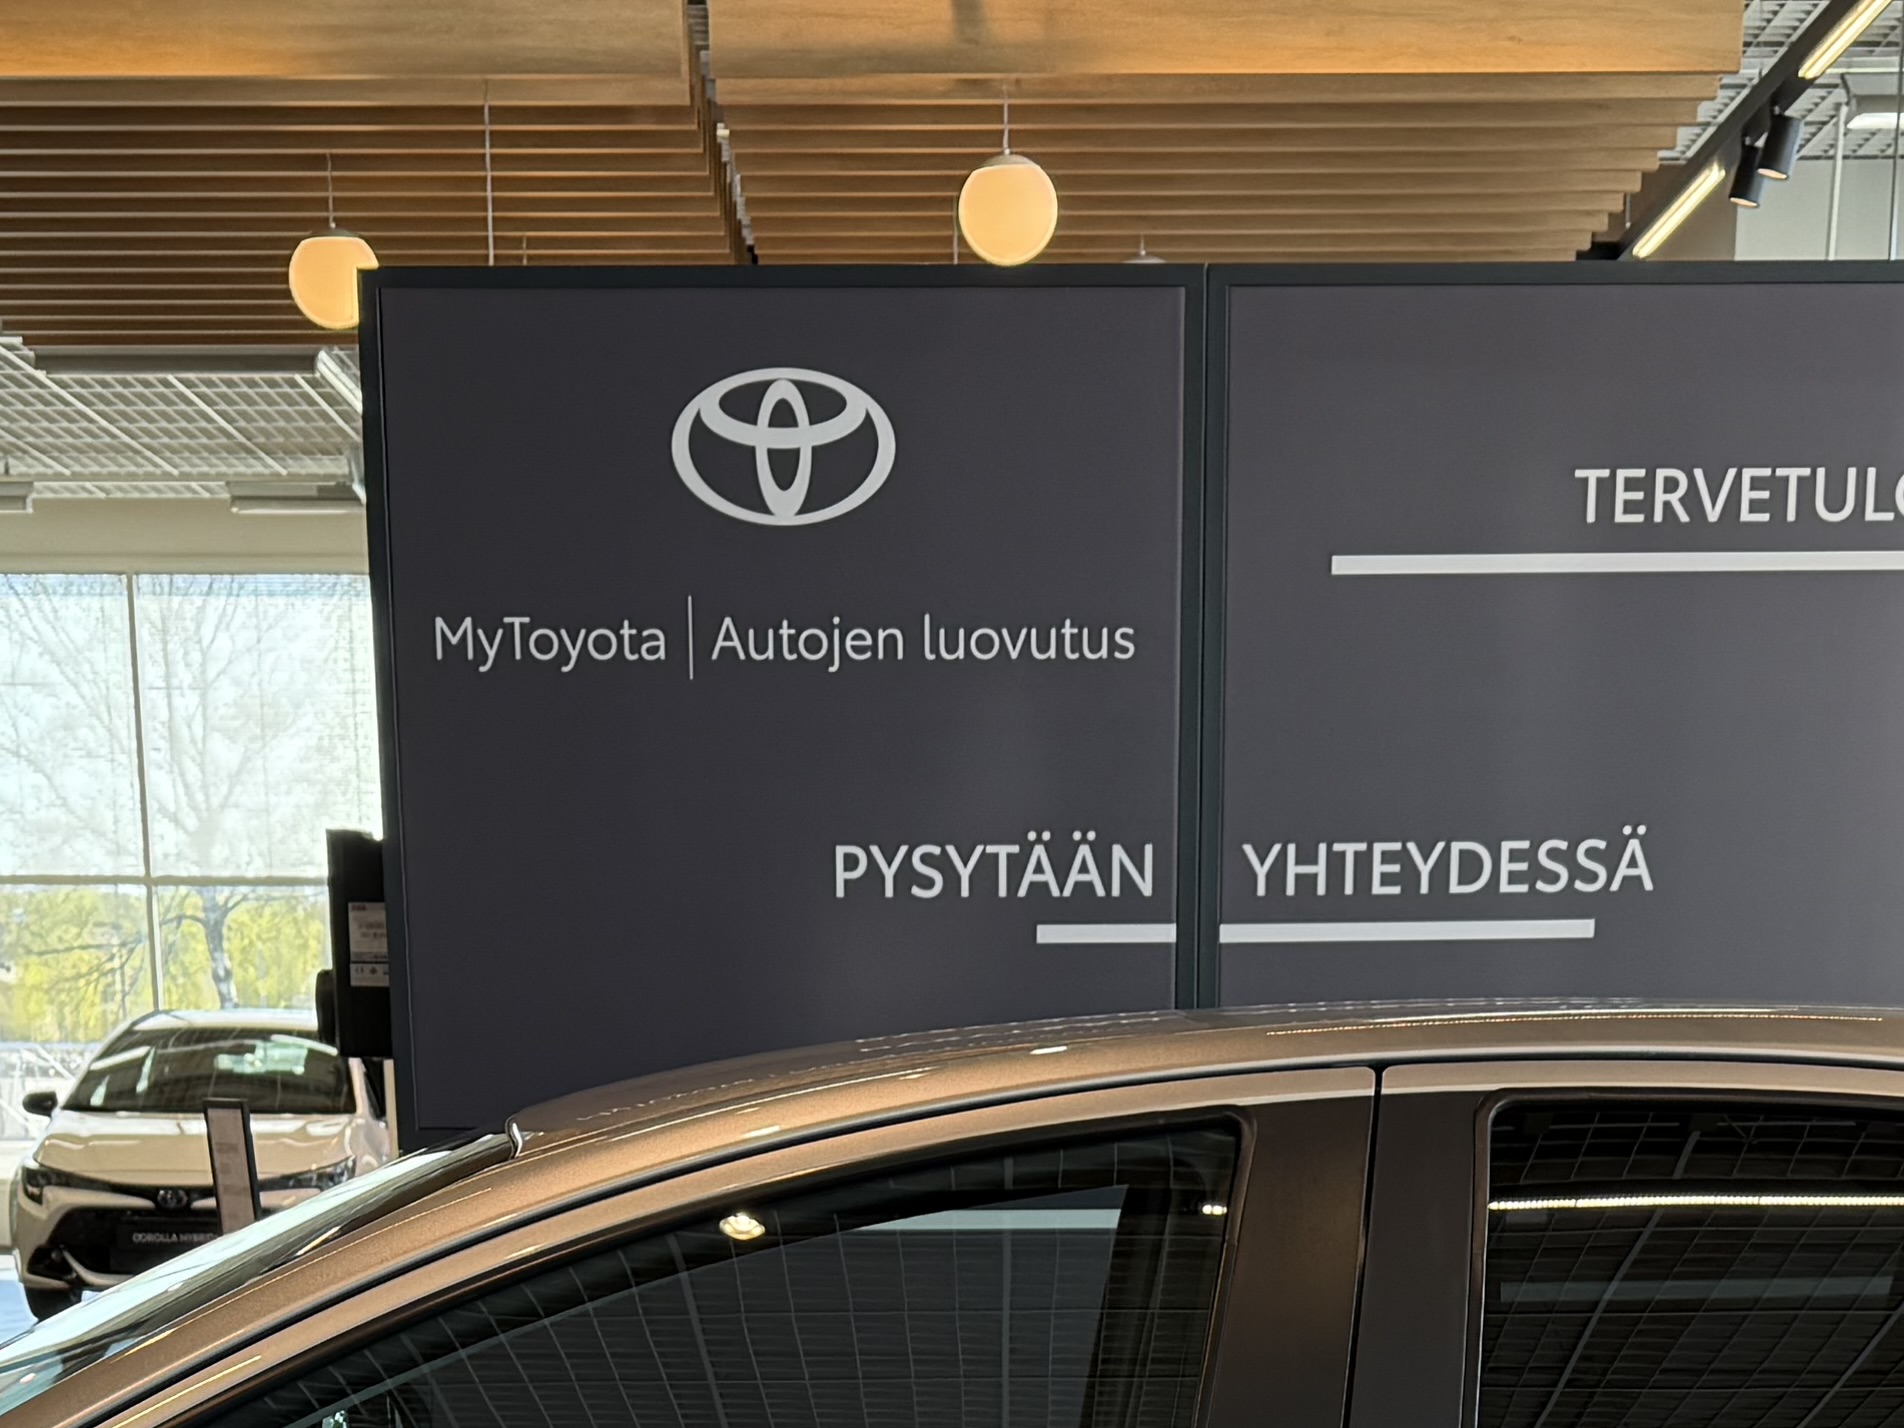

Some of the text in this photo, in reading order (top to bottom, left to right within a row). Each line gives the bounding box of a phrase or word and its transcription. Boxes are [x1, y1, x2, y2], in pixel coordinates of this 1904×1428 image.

[434, 613, 1136, 673] MyToyota Autojen luovutus
[834, 824, 1654, 899] PYSYTÄÄN YHTEYDESSÄ
